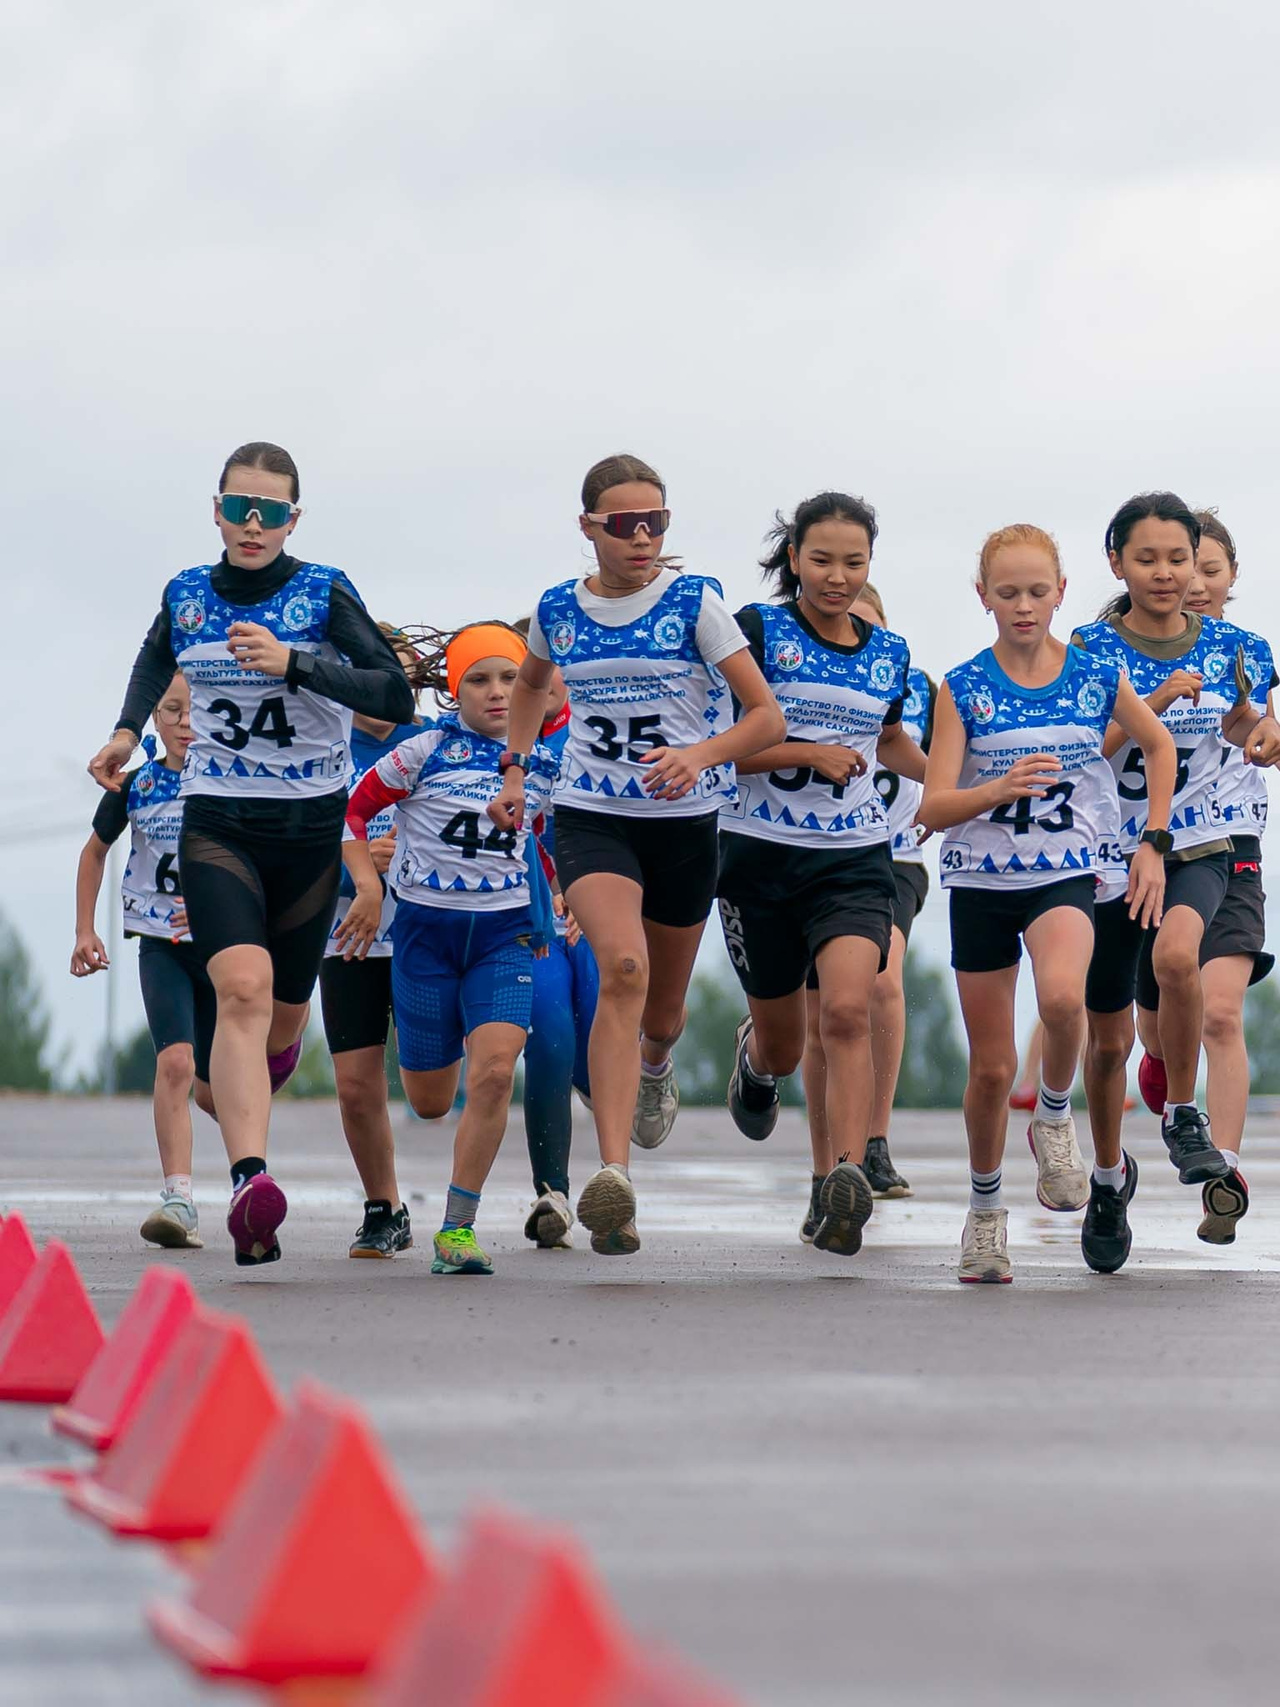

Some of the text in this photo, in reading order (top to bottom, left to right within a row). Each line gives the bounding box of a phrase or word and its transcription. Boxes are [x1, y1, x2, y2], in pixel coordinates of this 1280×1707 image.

[614, 676, 629, 684] ПО
[833, 704, 847, 713] ПО
[1170, 709, 1184, 717] ПО
[206, 696, 297, 751] 34
[785, 707, 831, 719] КУЛЬТУРЕ
[841, 716, 874, 729] СПОРТУ
[583, 713, 671, 764] 35
[1041, 744, 1056, 753] ПО
[1056, 751, 1091, 763] ПОРТУ
[990, 781, 1076, 836] 43
[1252, 803, 1268, 821] 47
[942, 850, 963, 869] 43
[1098, 842, 1124, 863] 43
